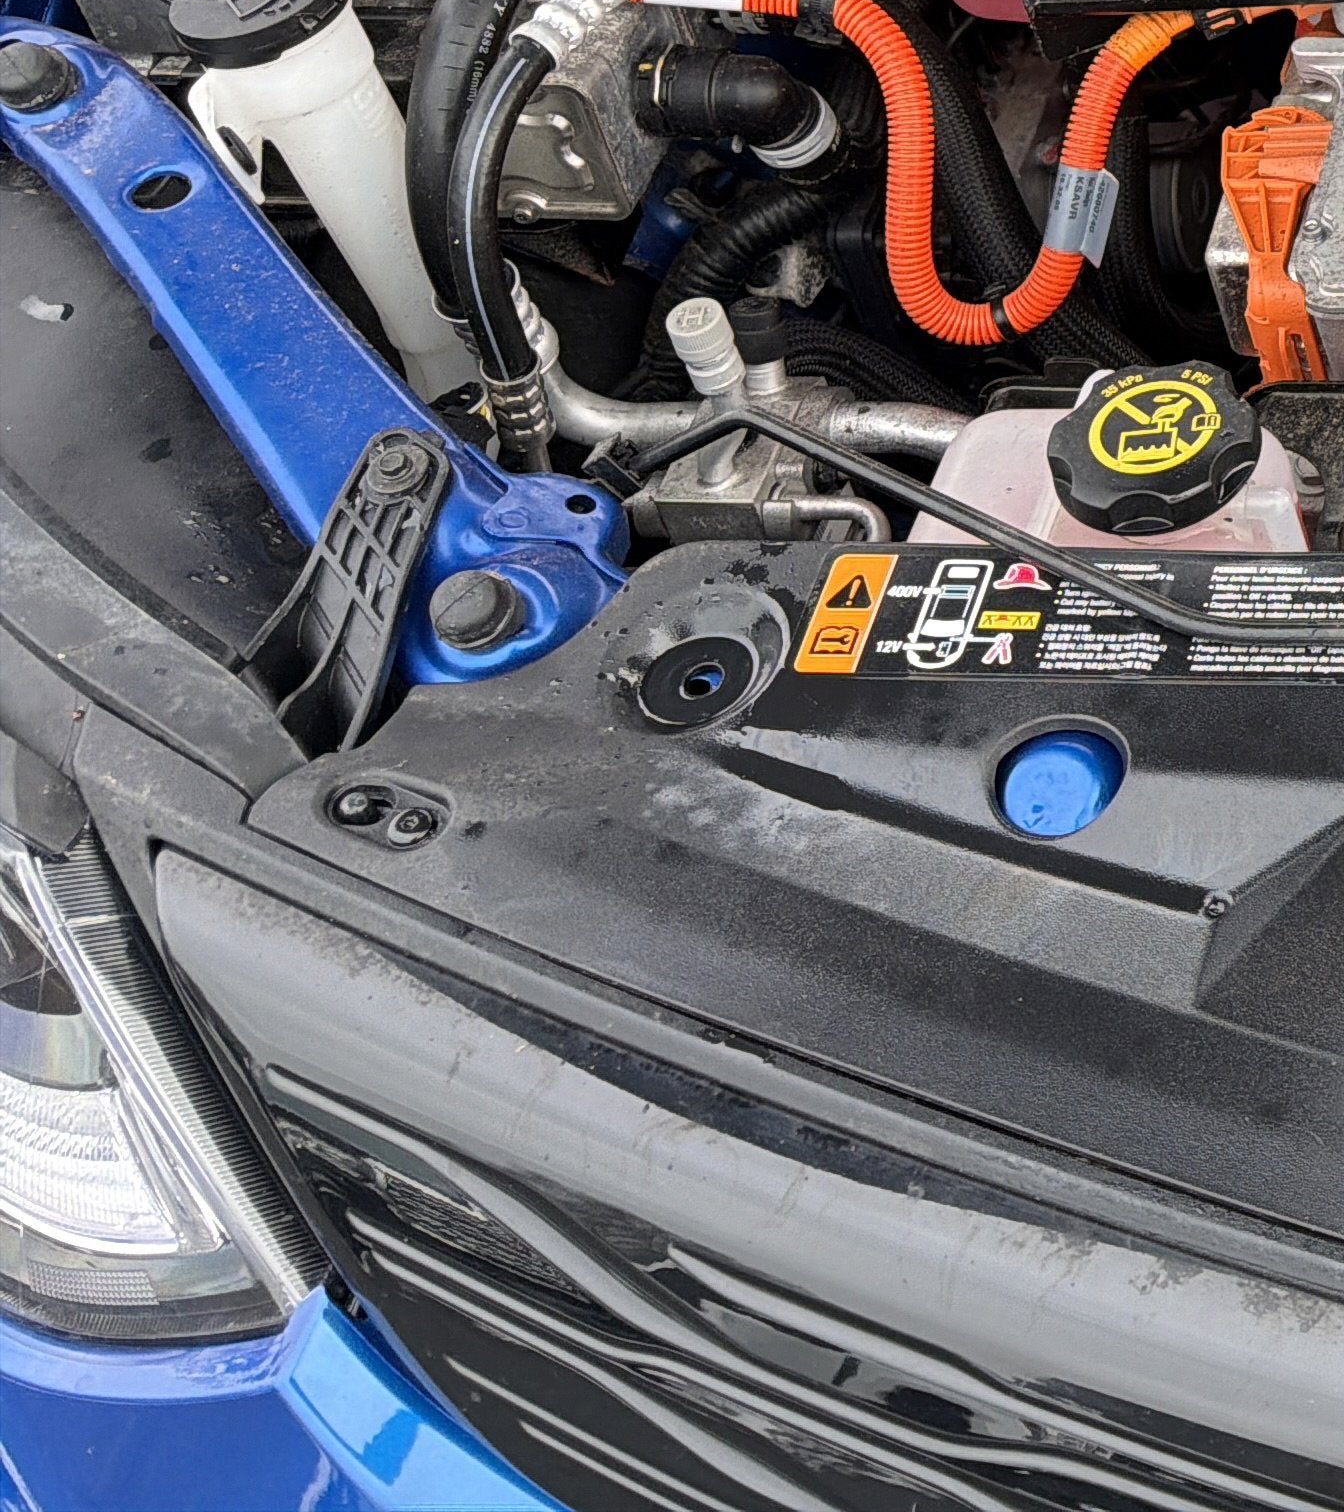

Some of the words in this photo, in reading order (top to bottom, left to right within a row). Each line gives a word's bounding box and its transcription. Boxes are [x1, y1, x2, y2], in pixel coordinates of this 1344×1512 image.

[1068, 176, 1085, 220] KSAVR
[1181, 369, 1193, 379] 5
[1190, 371, 1214, 385] PSI
[1101, 384, 1118, 398] 35
[1118, 374, 1144, 388] kPa
[1213, 566, 1258, 574] PERSONNEL
[1259, 566, 1303, 574] D'URGENCE
[886, 585, 923, 598] 400V
[875, 640, 903, 653] 12V
